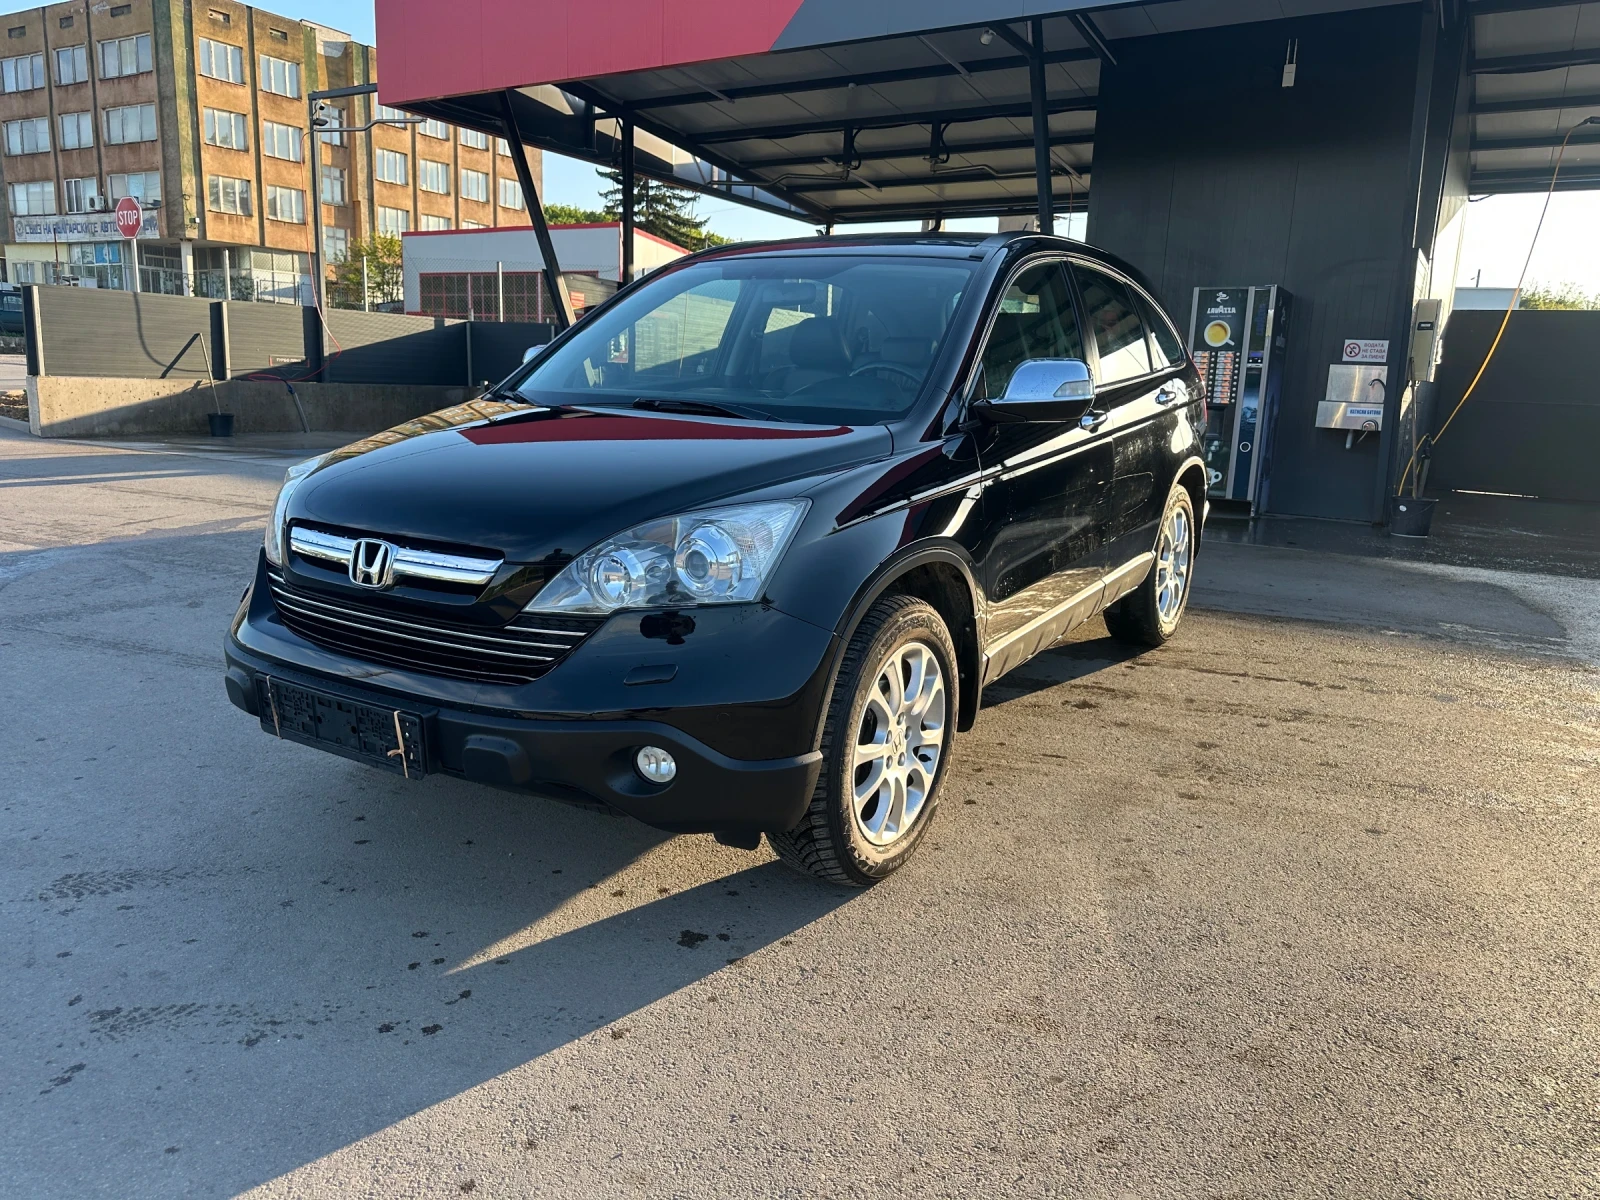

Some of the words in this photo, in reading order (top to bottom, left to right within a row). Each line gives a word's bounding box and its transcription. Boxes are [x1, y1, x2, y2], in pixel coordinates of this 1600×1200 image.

[118, 210, 138, 226] STOP
[43, 223, 52, 234] НА
[1206, 305, 1237, 314] LAVAZZA
